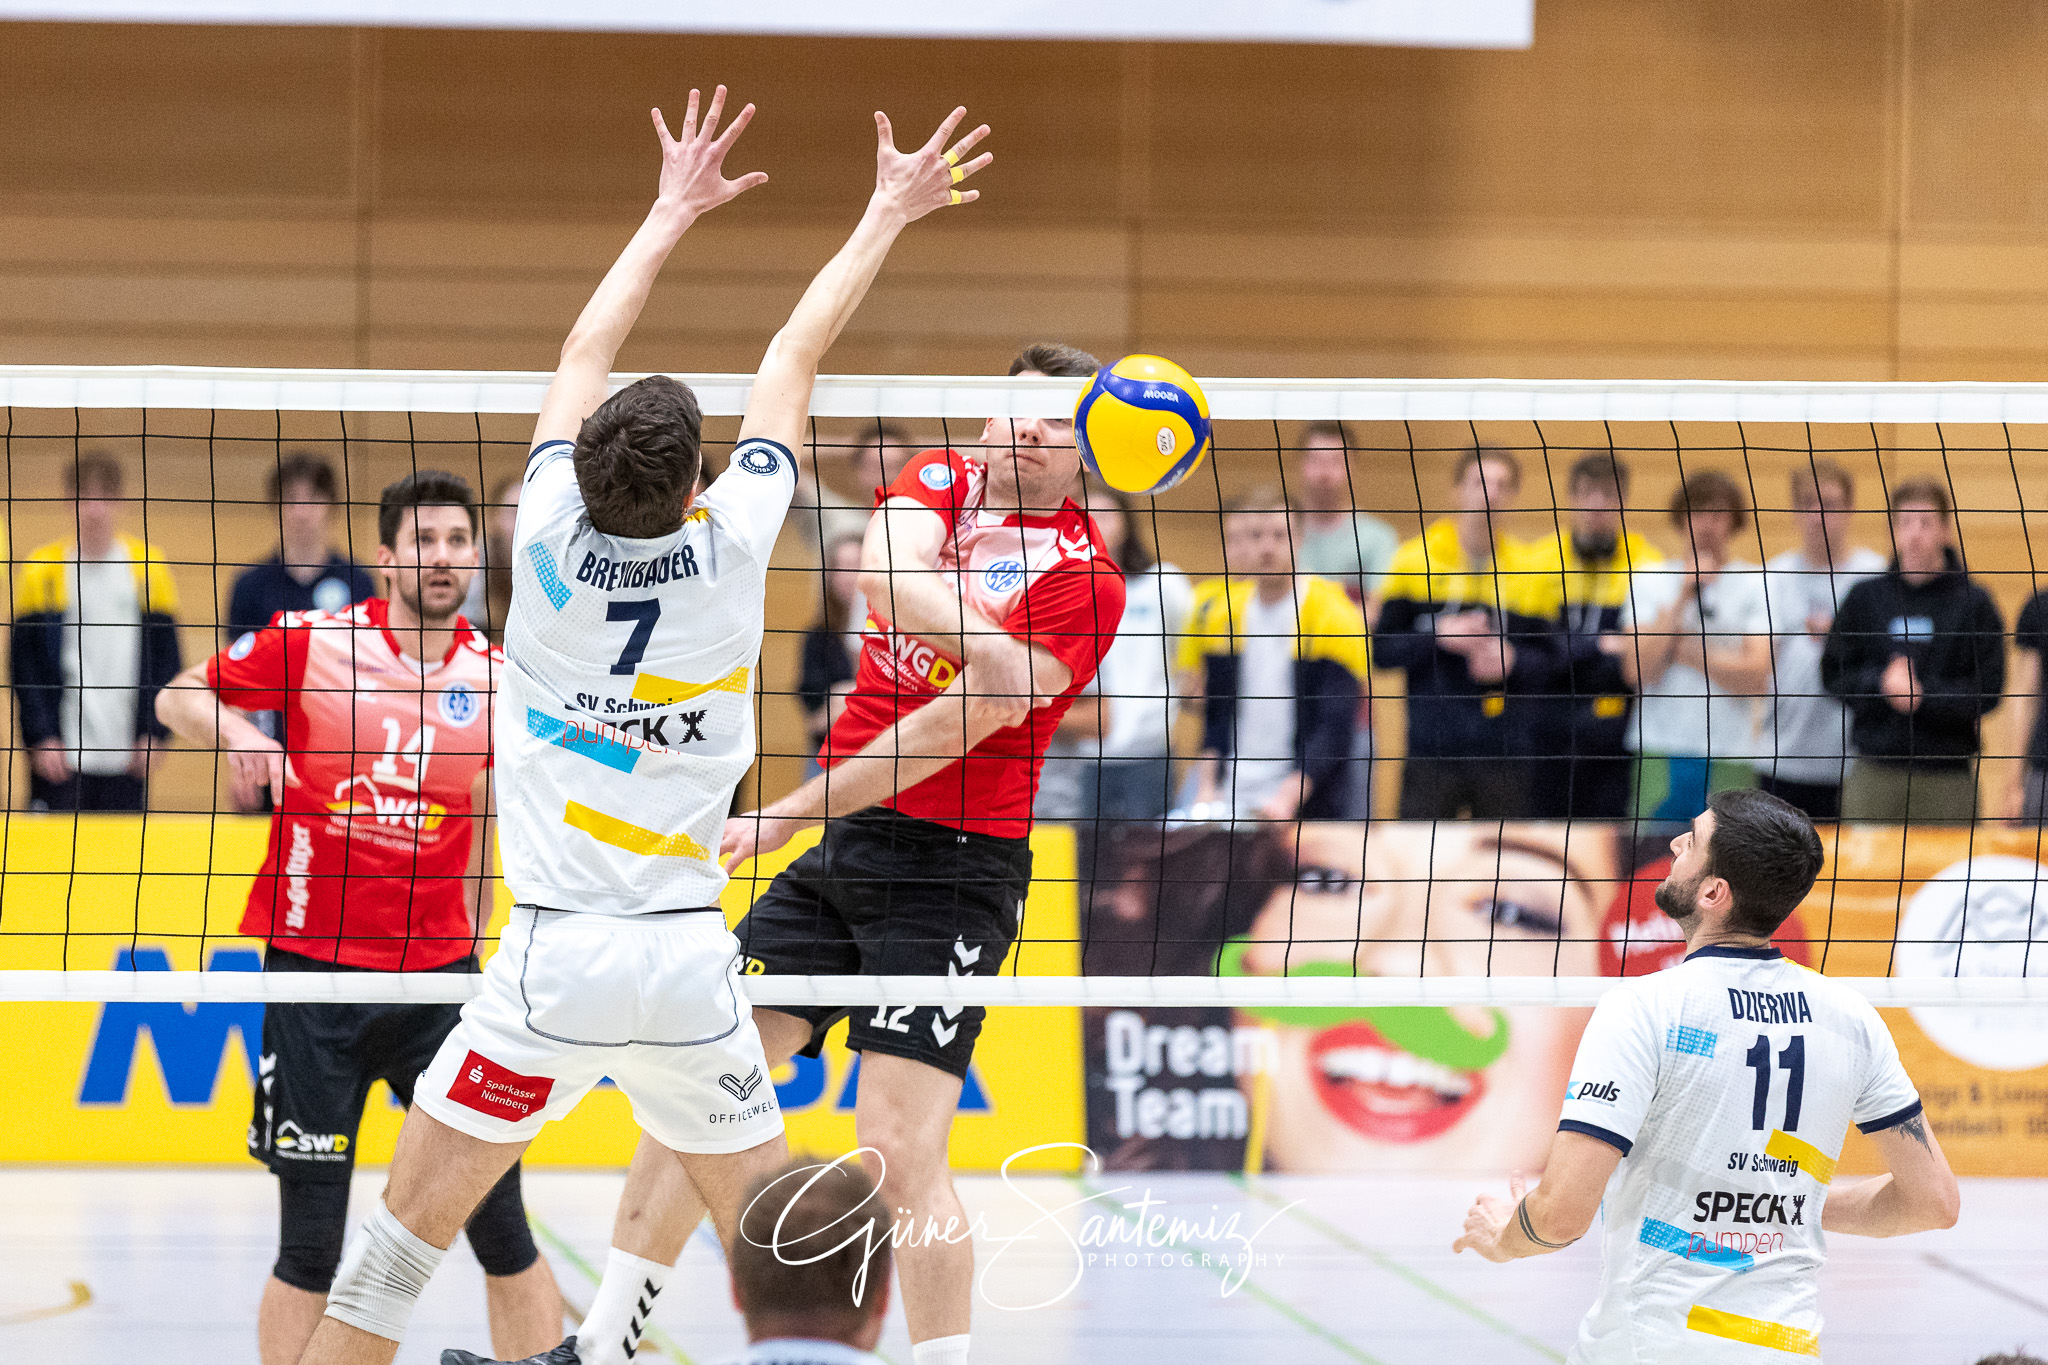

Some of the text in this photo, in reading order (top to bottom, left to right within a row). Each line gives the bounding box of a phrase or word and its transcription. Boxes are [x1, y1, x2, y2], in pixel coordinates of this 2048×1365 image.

[605, 597, 661, 675] 7
[576, 692, 600, 712] SV
[371, 717, 436, 783] 14
[373, 795, 447, 831] WGD
[870, 1006, 917, 1034] 12
[1727, 987, 1812, 1024] DZIERWA
[1105, 1010, 1279, 1077] Dream
[485, 1079, 536, 1100] Sparkasse
[1576, 1080, 1620, 1102] puls
[1746, 1034, 1805, 1132] 11
[481, 1089, 529, 1114] Nürnberg
[1105, 1074, 1248, 1140] Team
[298, 1133, 349, 1152] SWD
[1727, 1152, 1799, 1177] SV Schwaig
[1692, 1190, 1788, 1225] SPECK
[1686, 1231, 1784, 1261] pumpen
